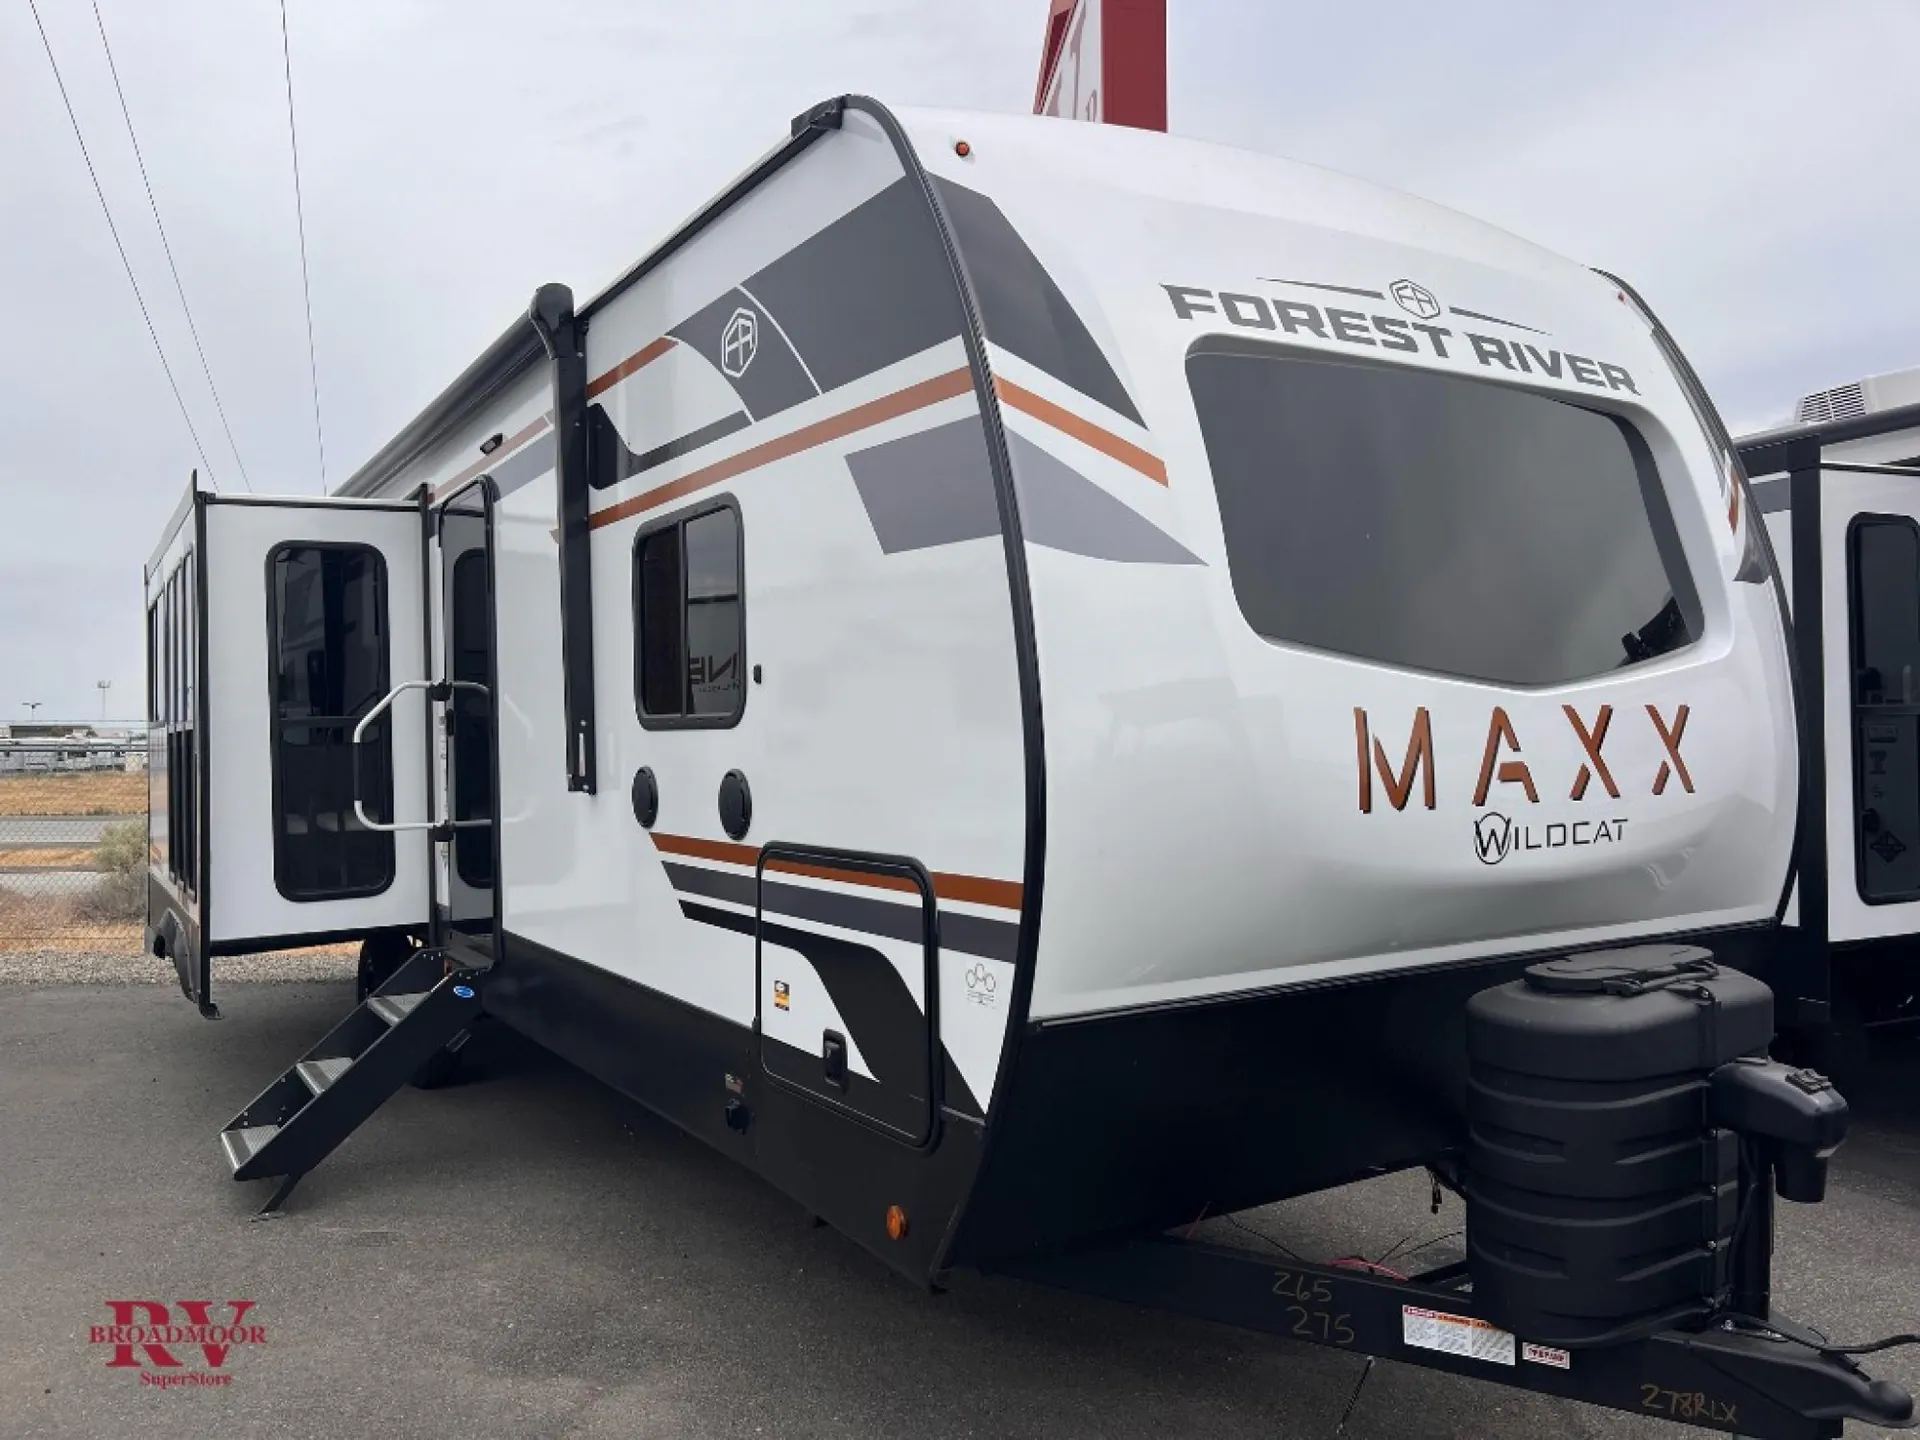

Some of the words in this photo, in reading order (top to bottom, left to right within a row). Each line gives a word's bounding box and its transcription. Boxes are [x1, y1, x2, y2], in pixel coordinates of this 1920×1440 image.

[1160, 284, 1452, 358] FOREST
[1467, 333, 1641, 396] RIVER
[1354, 704, 1695, 813] MAXX
[1272, 1271, 1333, 1302] 265
[1285, 1307, 1355, 1344] 275
